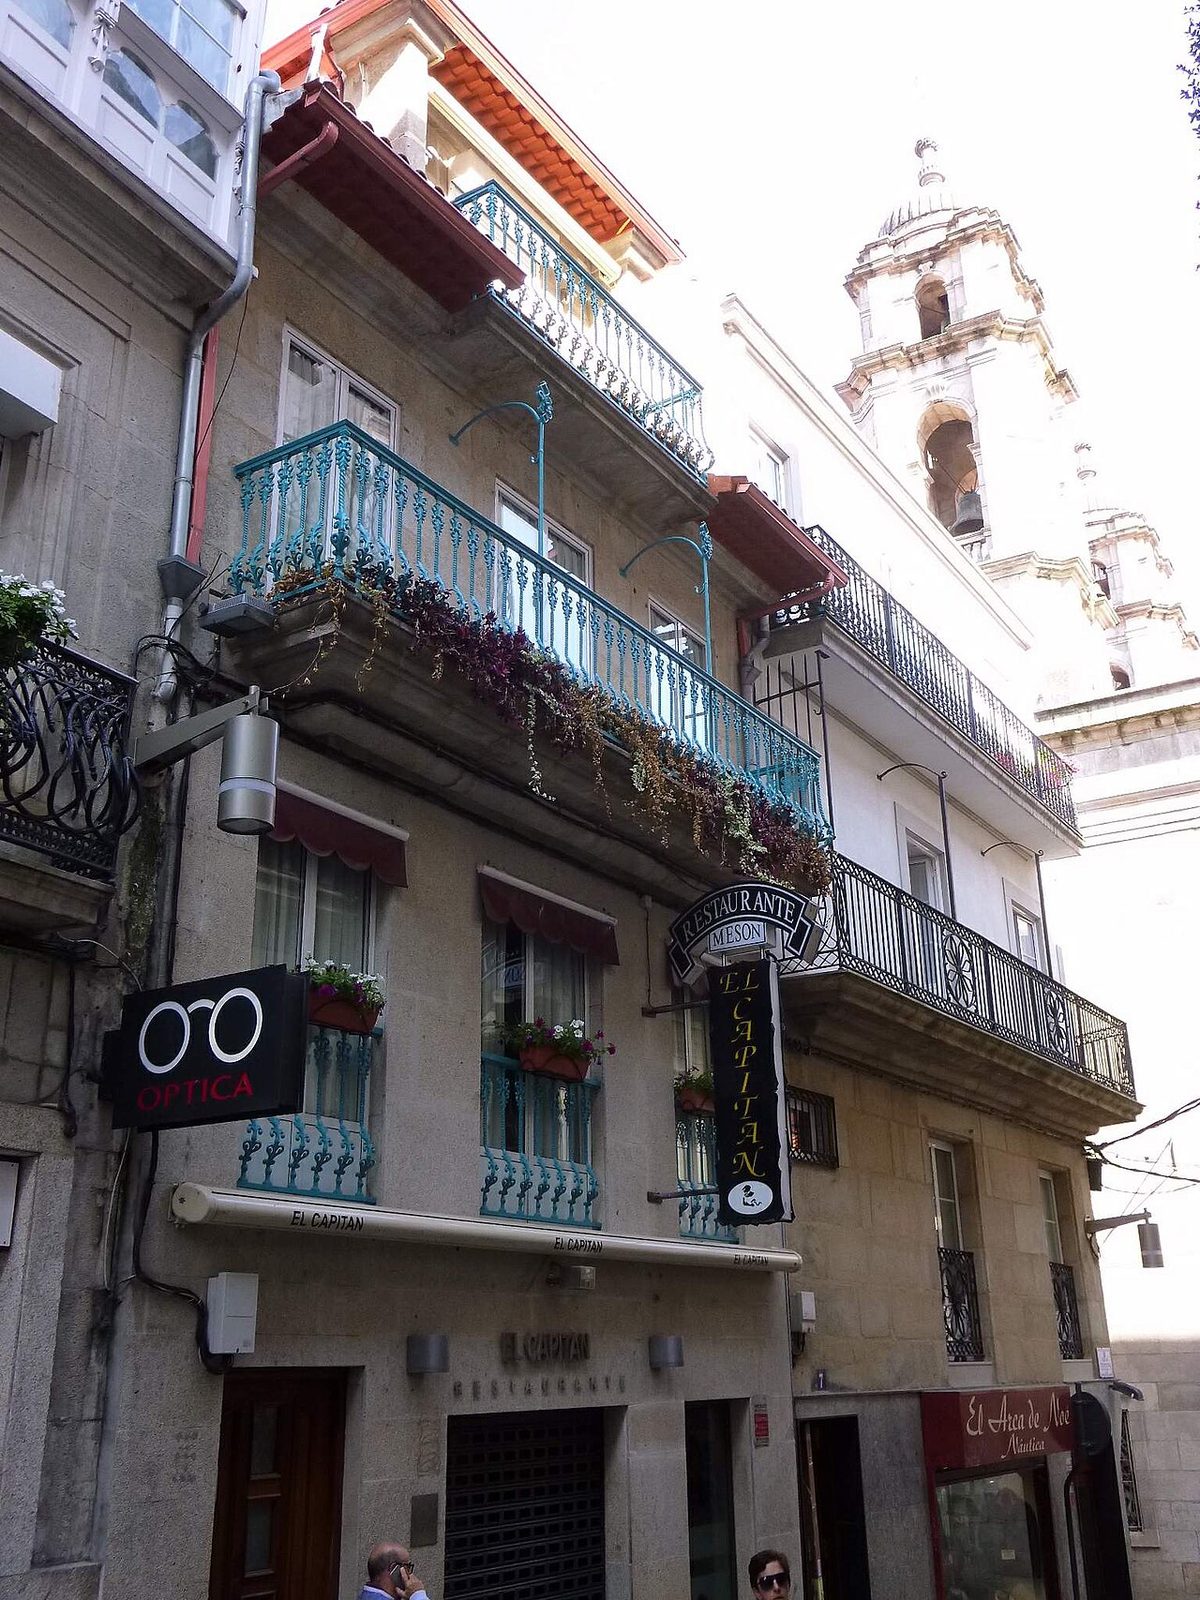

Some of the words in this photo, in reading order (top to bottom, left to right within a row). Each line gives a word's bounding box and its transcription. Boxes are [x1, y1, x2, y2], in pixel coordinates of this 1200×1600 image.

[682, 889, 796, 942] RESTAURANTE
[712, 922, 762, 947] MESON
[720, 969, 760, 993] EL
[137, 1072, 253, 1111] OPTICA
[290, 1210, 306, 1227] EL
[311, 1213, 364, 1231] CAPITAN
[554, 1236, 565, 1250] EL
[567, 1238, 603, 1253] CAPITAN
[733, 1254, 742, 1265] EL
[743, 1255, 769, 1265] CAPITAN
[966, 1395, 984, 1436] El
[988, 1394, 1025, 1433] Arca
[1028, 1399, 1040, 1429] de
